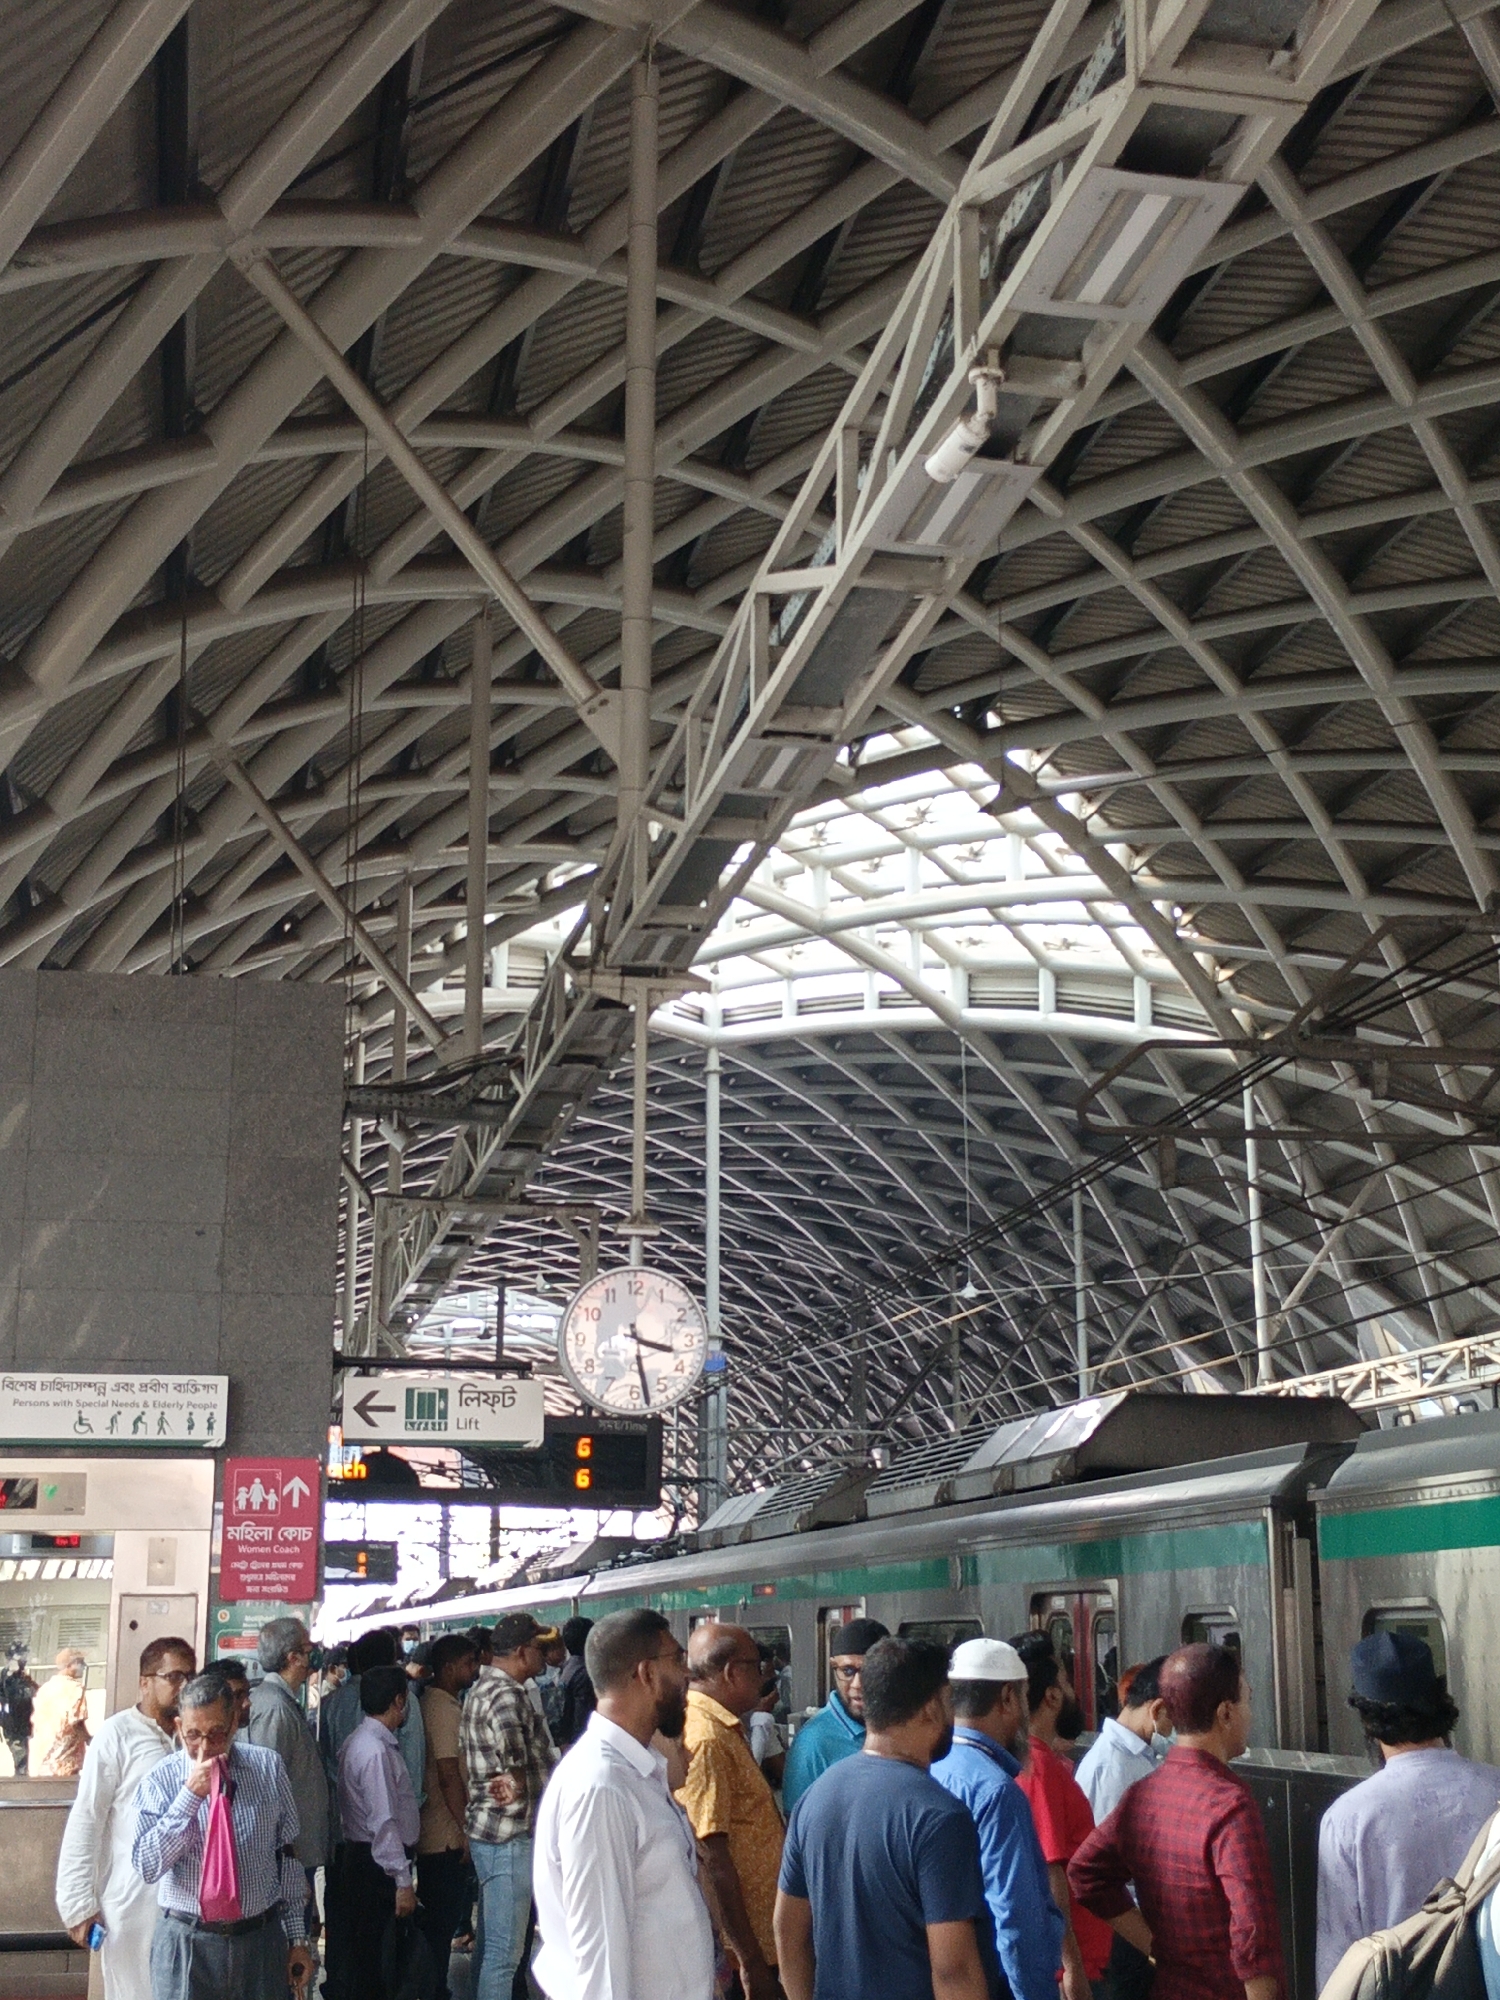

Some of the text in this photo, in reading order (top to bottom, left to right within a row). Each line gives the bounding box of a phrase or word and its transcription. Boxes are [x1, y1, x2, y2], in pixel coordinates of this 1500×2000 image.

[627, 1280, 644, 1295] 12
[604, 1288, 616, 1303] 11
[658, 1288, 665, 1303] 1
[584, 1307, 602, 1322] 10
[676, 1307, 687, 1322] 2
[575, 1332, 586, 1347] 9
[683, 1333, 695, 1348] 3
[584, 1358, 595, 1374] 8
[674, 1360, 685, 1374] 4
[2, 1376, 37, 1391] বিশেষ
[111, 1382, 135, 1394] এবং
[138, 1378, 169, 1394] প্রবীণ
[605, 1376, 616, 1391] 7
[656, 1377, 668, 1392] 5
[629, 1385, 640, 1400] 6
[13, 1398, 218, 1411] Persons with Special Needs & Elderly People
[456, 1417, 480, 1430] Lift
[577, 1437, 592, 1459] 6
[575, 1468, 591, 1489] 6
[226, 1521, 314, 1542] মহিলা কোচ
[238, 1544, 301, 1554] Women Coach
